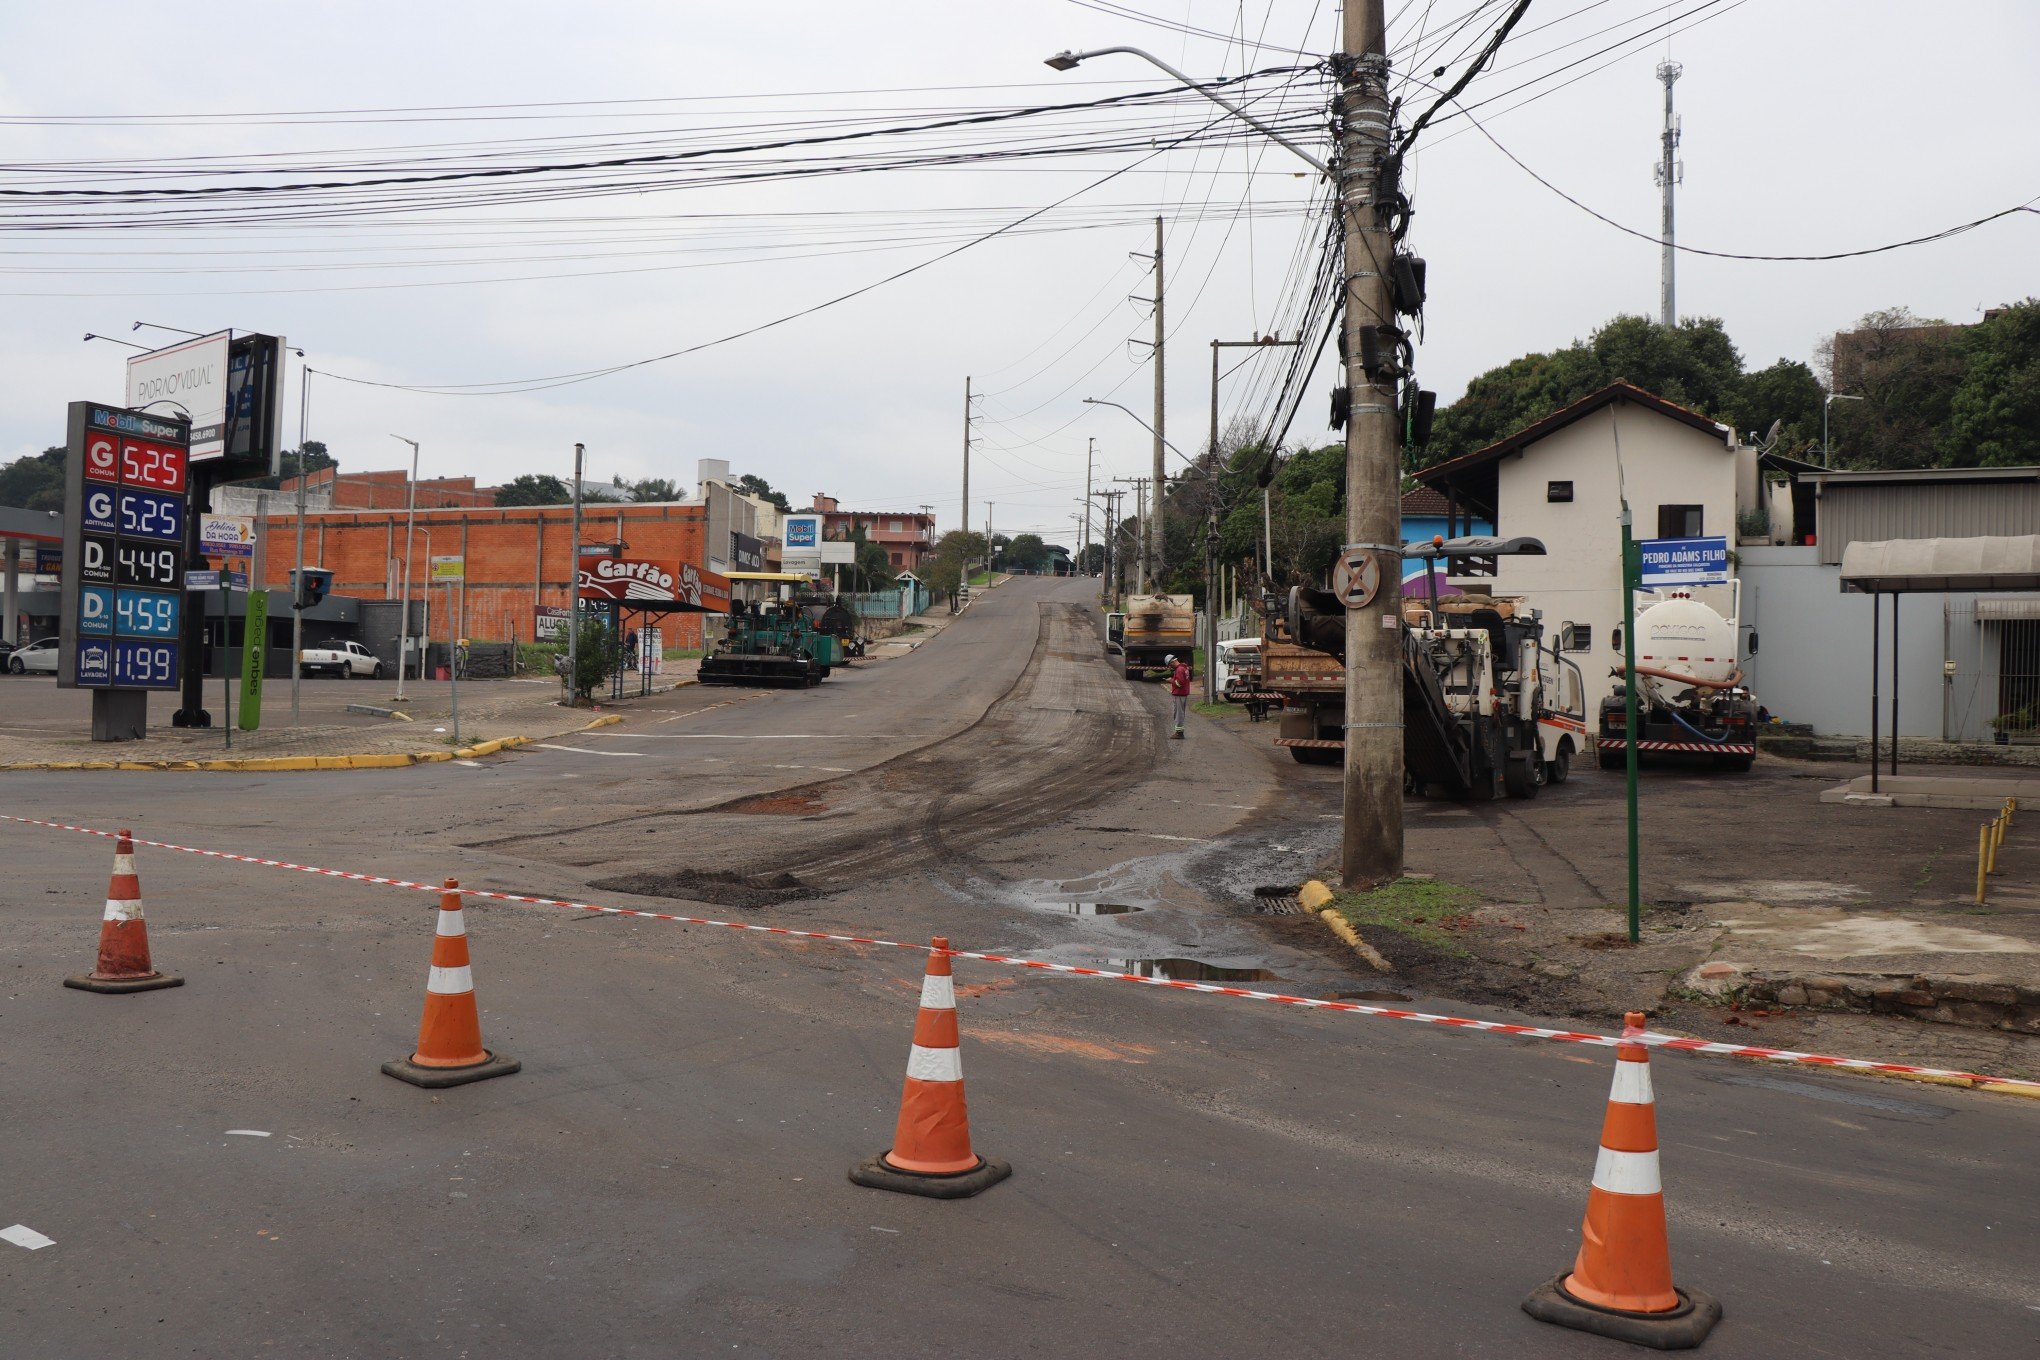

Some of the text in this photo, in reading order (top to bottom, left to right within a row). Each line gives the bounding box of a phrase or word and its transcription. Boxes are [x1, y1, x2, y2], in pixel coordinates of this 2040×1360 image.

[94, 409, 179, 438] Mobil Super
[91, 441, 114, 468] G
[89, 467, 115, 477] COMUM
[89, 492, 112, 519] G
[84, 519, 115, 528] ADITIVADA
[785, 525, 813, 533] Mobil
[218, 532, 239, 541] HORA
[785, 533, 815, 543] Super
[84, 541, 104, 569] D
[1642, 549, 1726, 564] PEDRO ADAMS FILHO
[83, 569, 109, 578] COMUM
[597, 560, 673, 588] Garfão
[84, 592, 104, 618] D
[82, 621, 108, 629] COMUM
